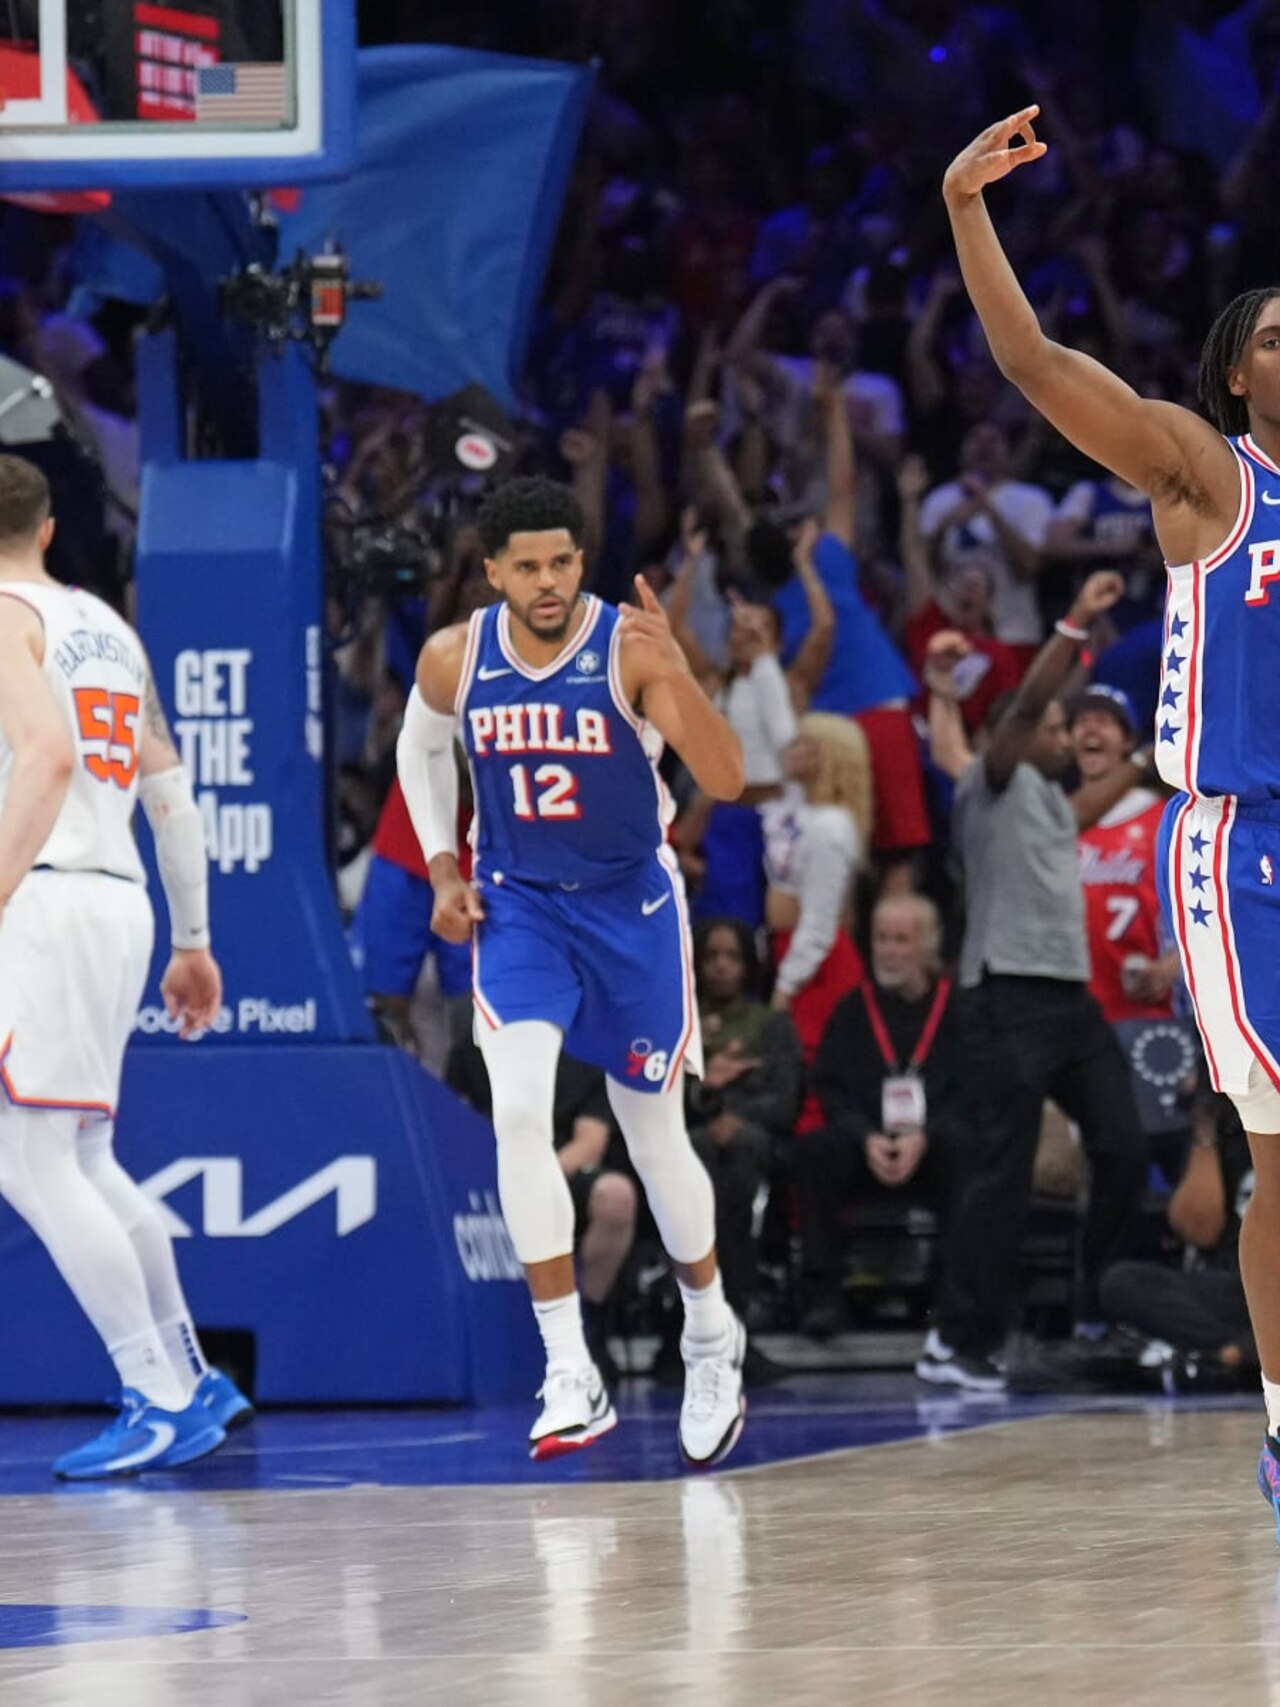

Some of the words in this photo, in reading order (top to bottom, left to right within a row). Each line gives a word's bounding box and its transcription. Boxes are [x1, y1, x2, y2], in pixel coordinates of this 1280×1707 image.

[174, 648, 253, 718] GET
[71, 687, 140, 791] 55
[173, 718, 254, 787] THE
[468, 703, 613, 758] PHILA
[509, 763, 583, 822] 12
[197, 790, 273, 875] App
[1105, 896, 1140, 941] 7
[238, 998, 317, 1034] Pixel
[625, 1050, 668, 1082] 76
